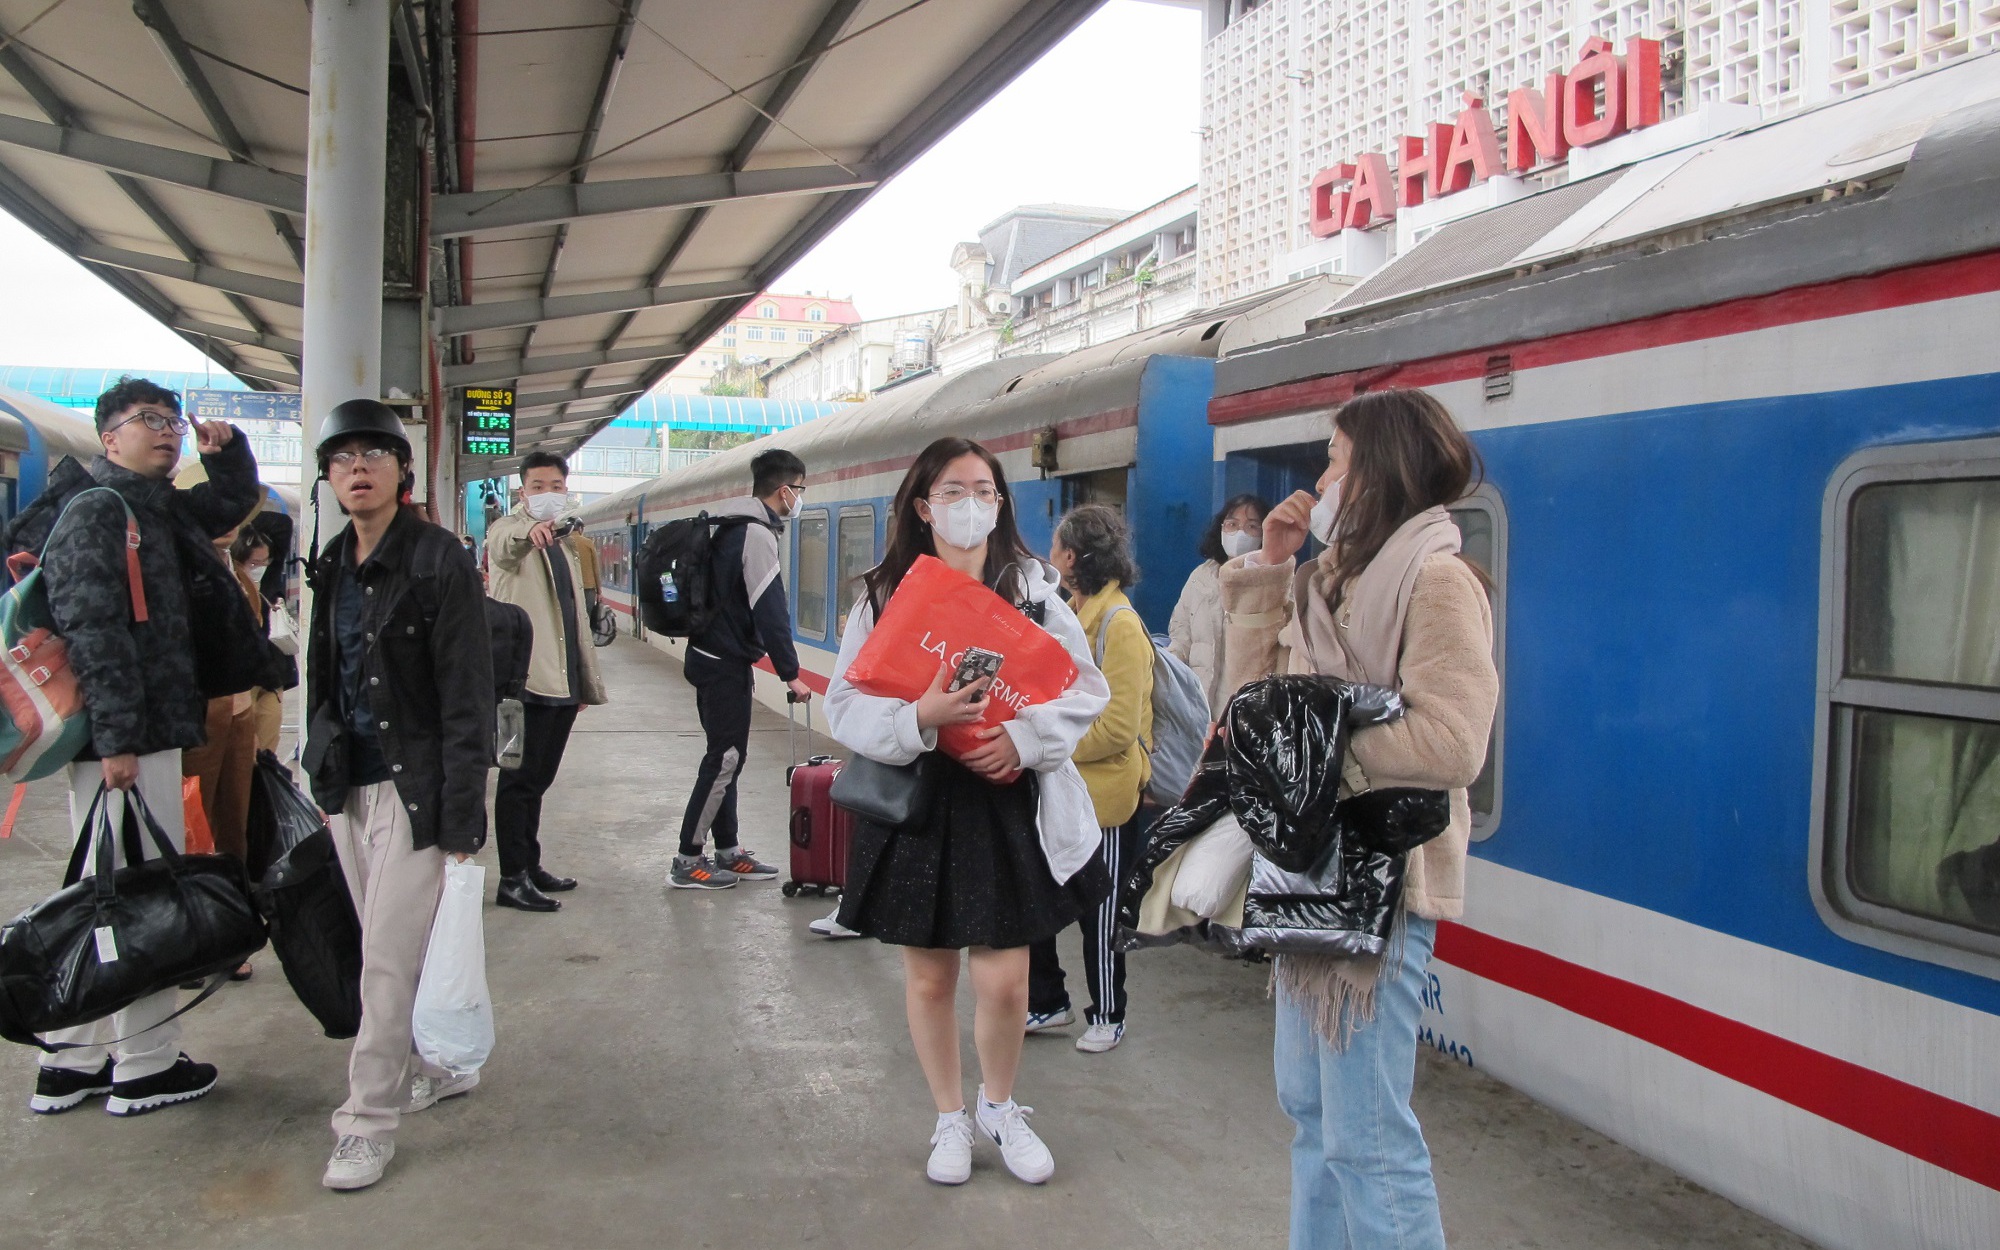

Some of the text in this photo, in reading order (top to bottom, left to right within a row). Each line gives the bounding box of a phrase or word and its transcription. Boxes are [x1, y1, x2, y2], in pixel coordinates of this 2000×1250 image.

[1310, 153, 1396, 239] GA
[1398, 89, 1504, 207] HÀ
[198, 406, 226, 416] EXIT
[233, 406, 241, 416] 4
[266, 407, 274, 418] 3
[504, 392, 512, 405] 3
[920, 631, 946, 660] LA
[950, 651, 1031, 712] CRMÉ
